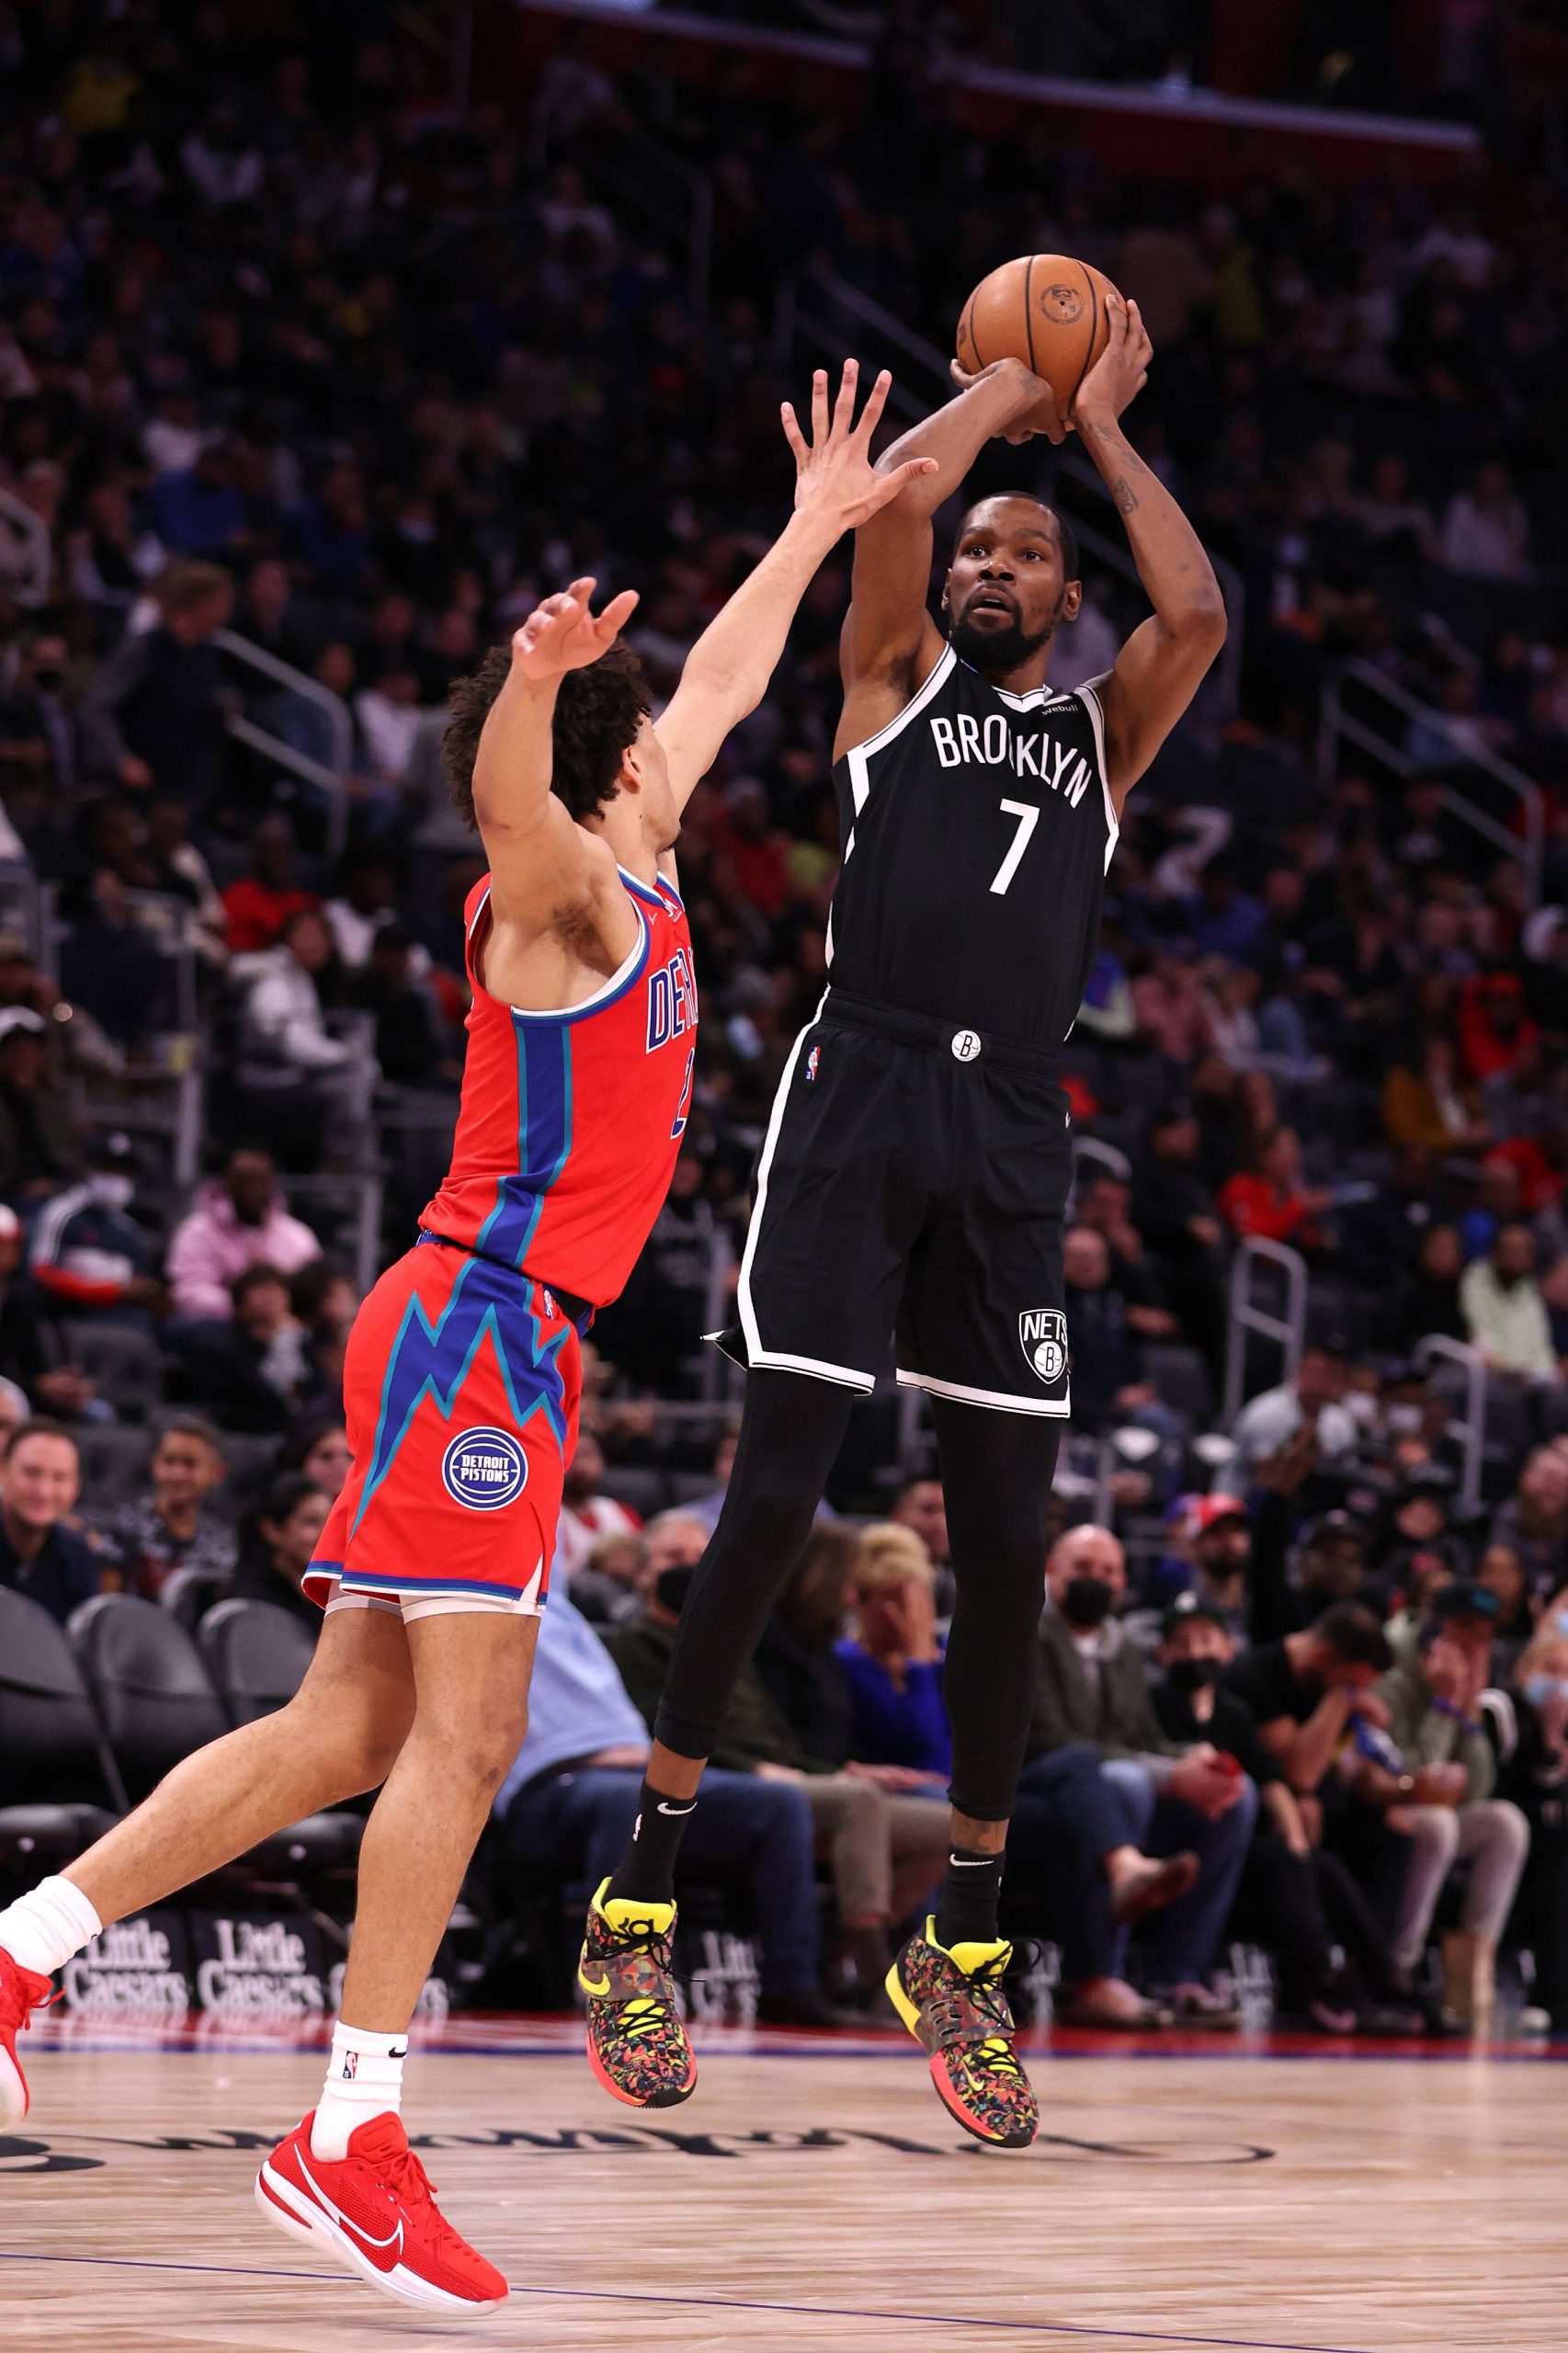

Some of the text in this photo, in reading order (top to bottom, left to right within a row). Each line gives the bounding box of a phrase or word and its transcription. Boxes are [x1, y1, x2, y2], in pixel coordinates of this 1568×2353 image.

[930, 713, 1092, 809] BROKLYN
[989, 798, 1040, 895] 7
[460, 1468, 509, 1483] PISTONS
[461, 1454, 510, 1470] DETROIT
